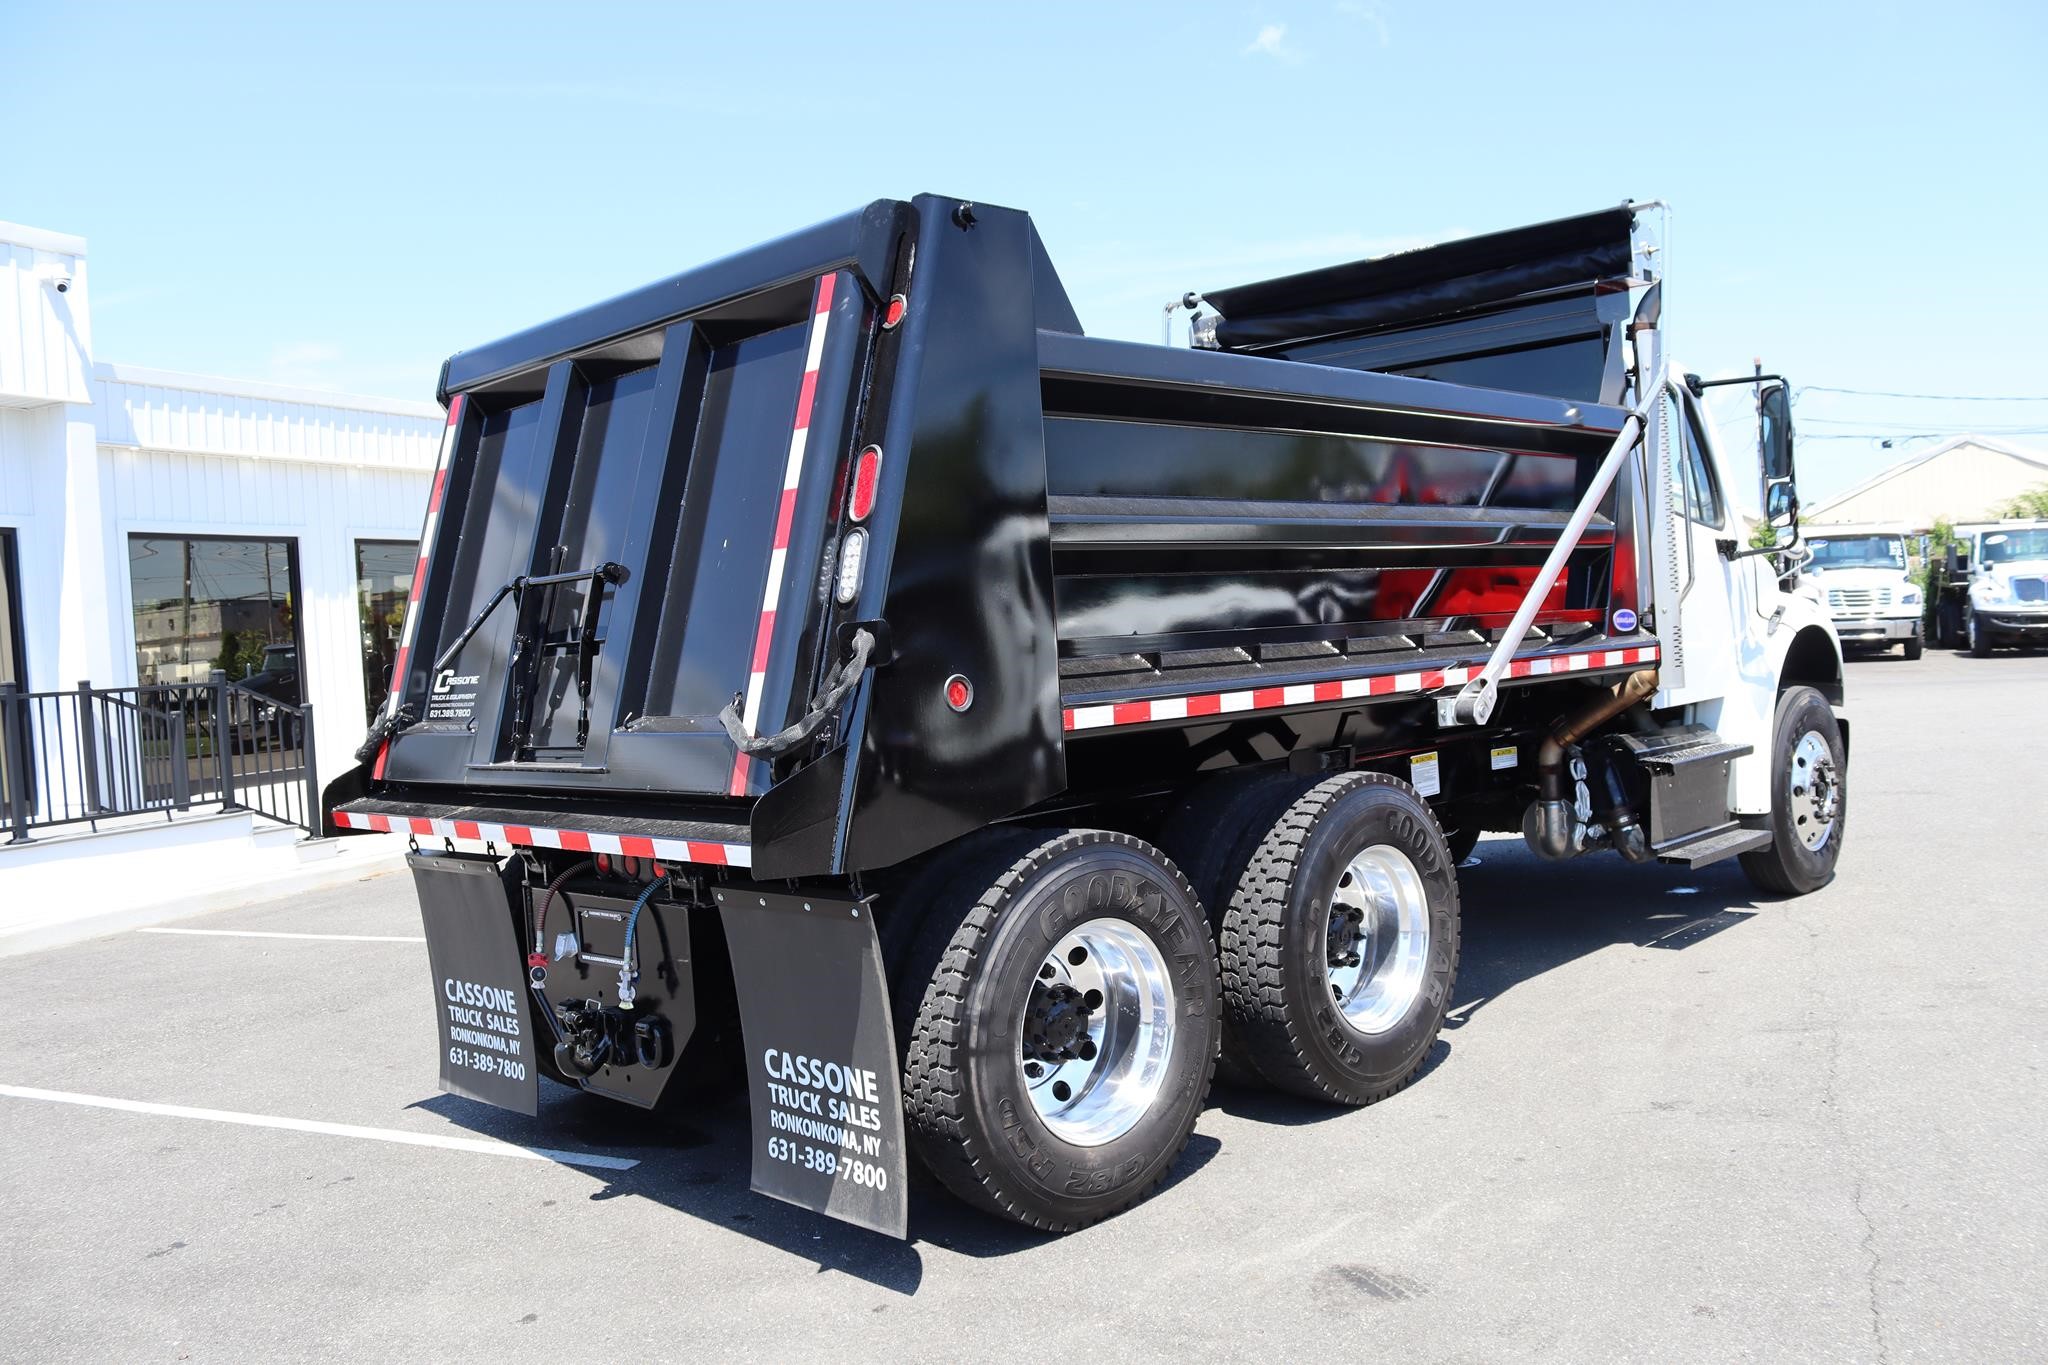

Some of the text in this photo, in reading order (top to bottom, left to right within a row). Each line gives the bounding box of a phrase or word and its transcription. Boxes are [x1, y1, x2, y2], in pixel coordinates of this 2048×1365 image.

[1039, 874, 1205, 1018] GOODYEAR
[445, 978, 518, 1015] CASSONE
[448, 1004, 520, 1036] TRUCK SALES
[449, 1047, 525, 1081] 631-389-7800
[451, 1026, 521, 1056] RONKONKOMA, NY
[764, 1048, 880, 1104] CASSONE
[767, 1082, 881, 1131] TRUCK SALES
[770, 1109, 881, 1158] RONKONKOMA, NY
[767, 1136, 887, 1192] 631-389-7800
